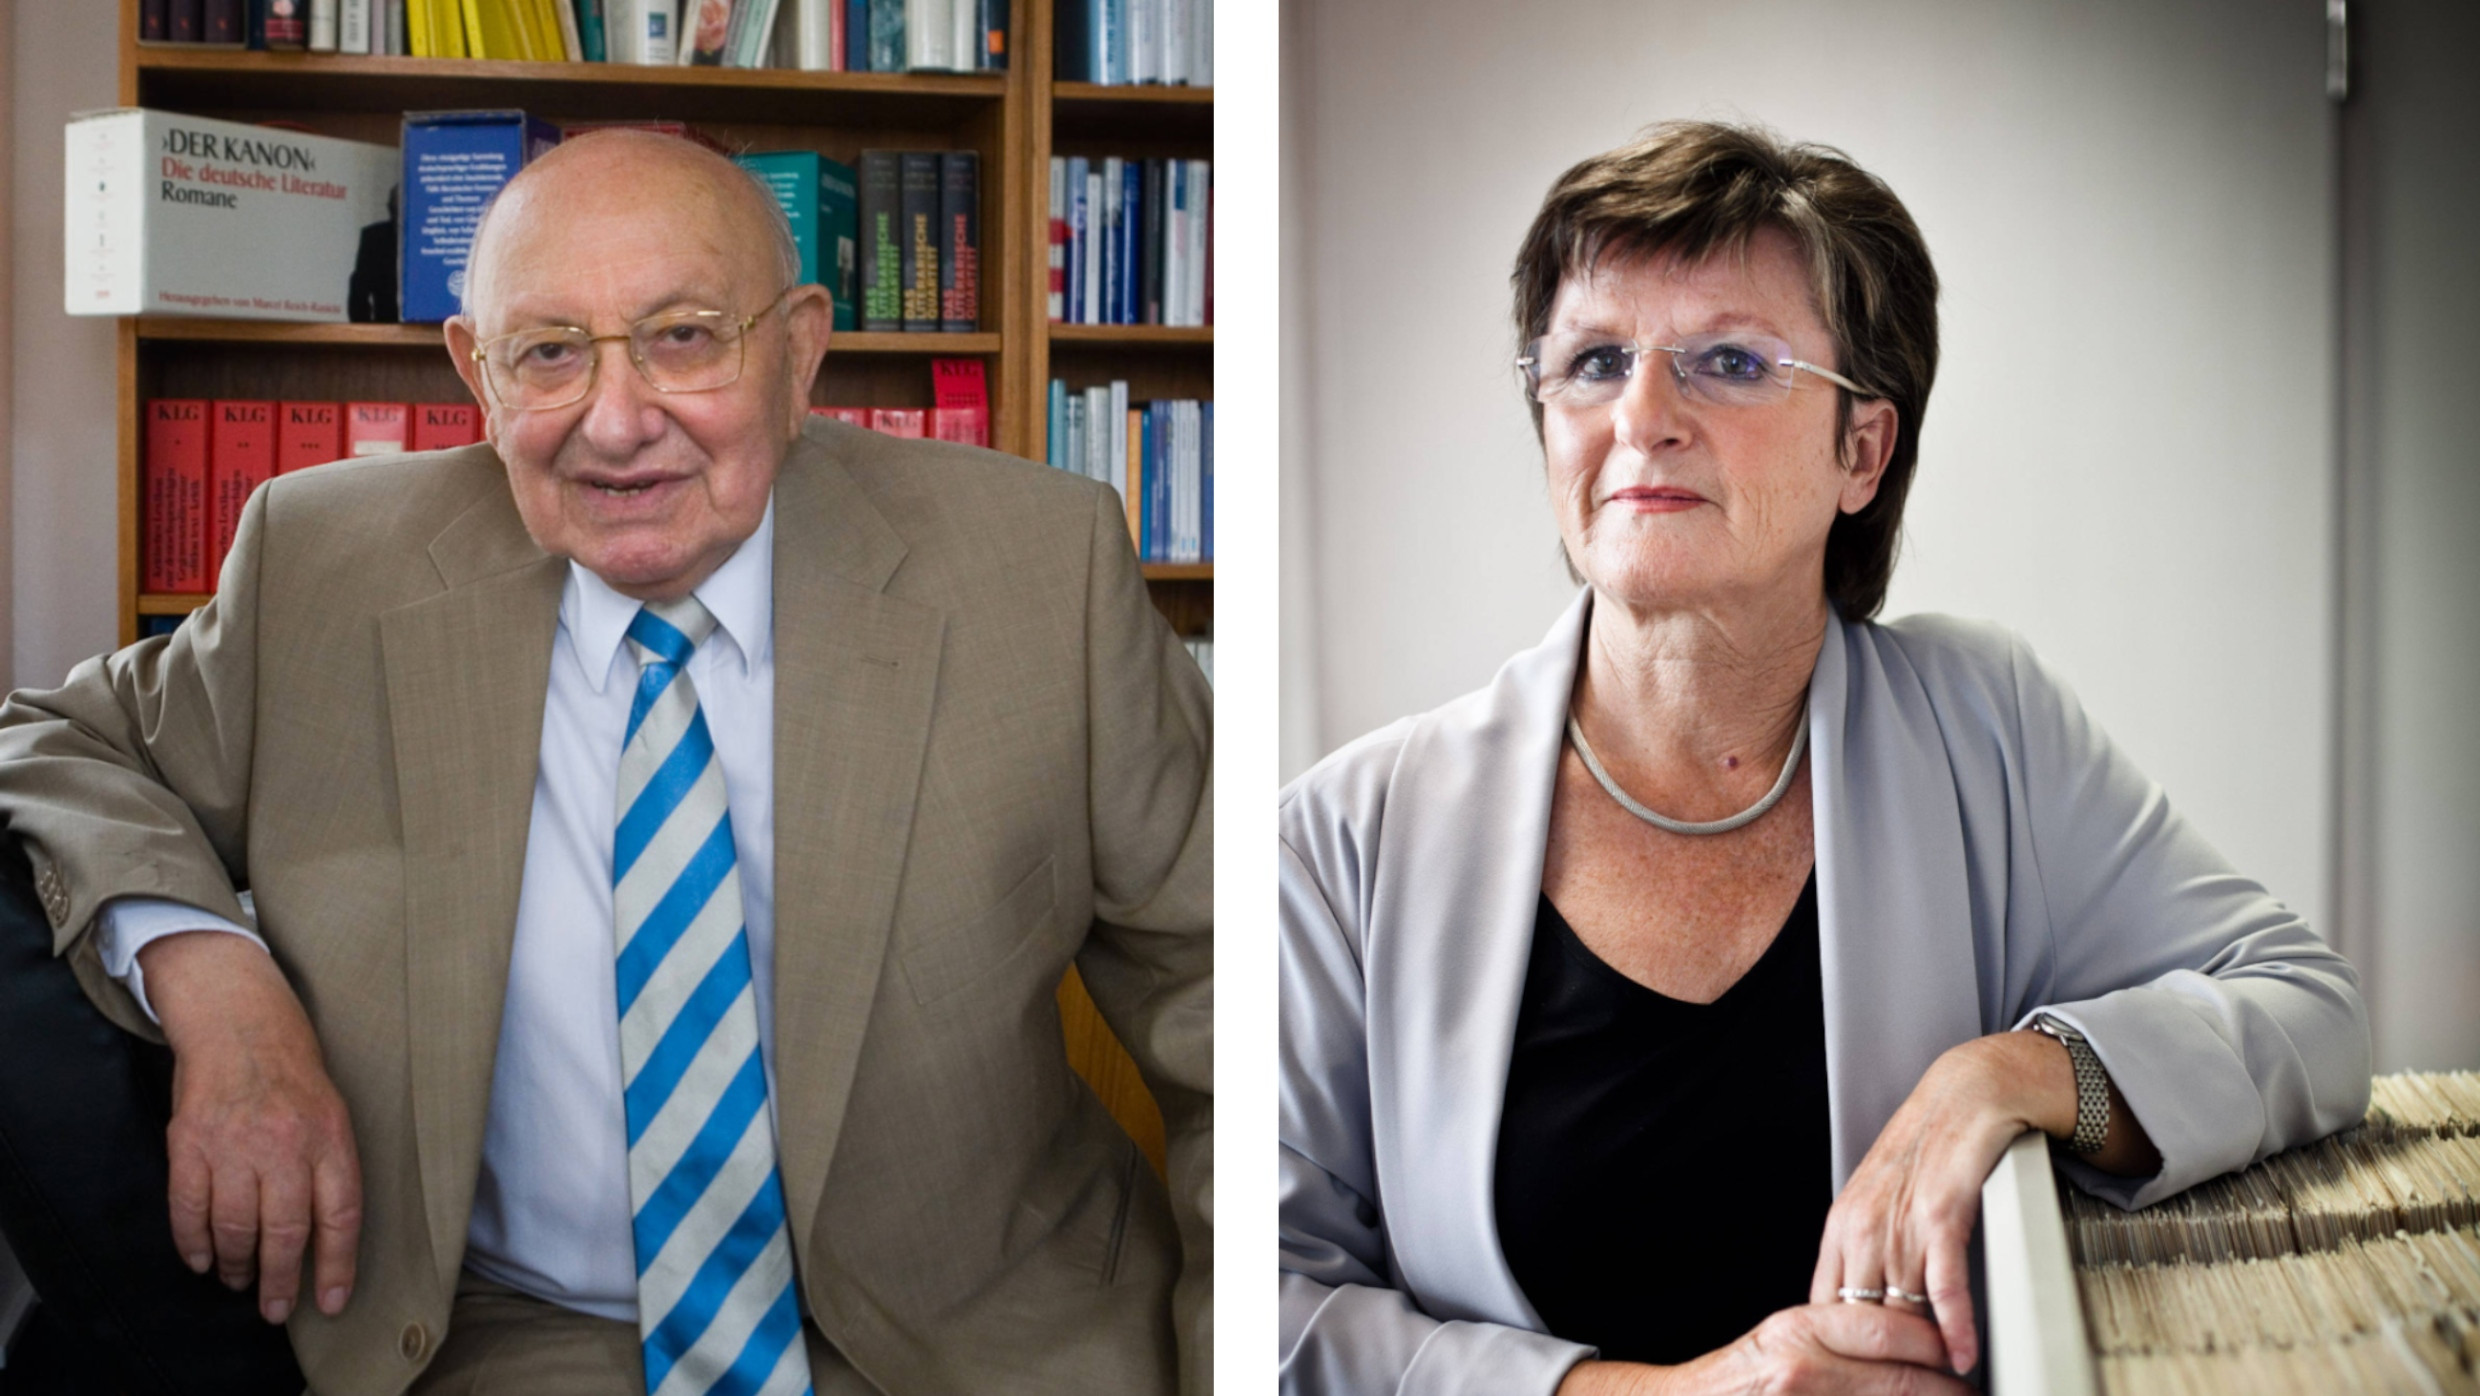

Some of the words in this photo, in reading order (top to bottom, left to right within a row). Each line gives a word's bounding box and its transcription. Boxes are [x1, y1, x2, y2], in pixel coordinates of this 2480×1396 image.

[161, 157, 192, 180] Die
[198, 164, 276, 192] deutsche
[281, 174, 347, 201] Literatur
[161, 180, 238, 209] Romane
[889, 244, 900, 318] QUARTETT
[927, 246, 938, 320] QUARTETT
[966, 246, 977, 320] QUARTETT
[866, 288, 877, 319] DAS
[905, 289, 915, 320] DAS
[943, 289, 953, 320] DAS
[941, 362, 977, 376] KLG
[158, 403, 199, 422] KLG
[225, 405, 266, 423] KLG
[291, 406, 332, 425] KLG
[357, 404, 399, 423] KLG
[427, 408, 468, 426] KLG
[881, 414, 917, 428] KLG
